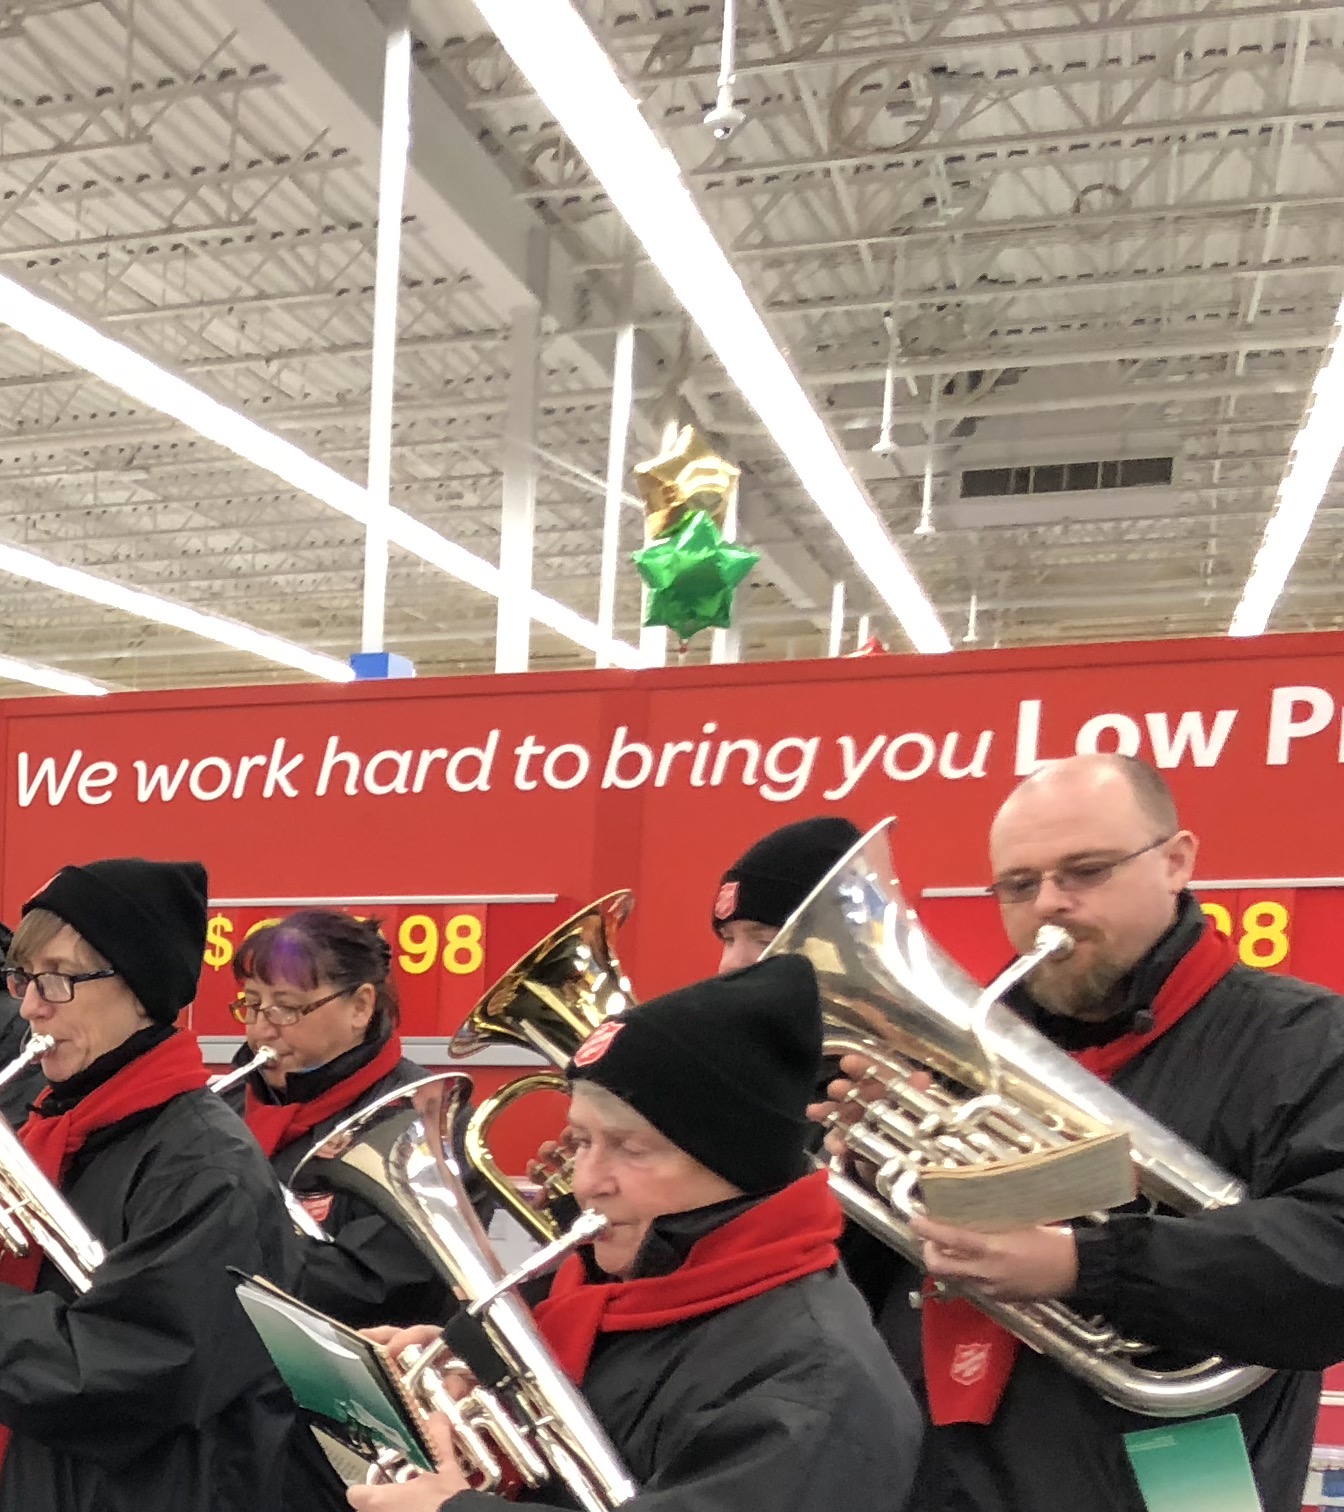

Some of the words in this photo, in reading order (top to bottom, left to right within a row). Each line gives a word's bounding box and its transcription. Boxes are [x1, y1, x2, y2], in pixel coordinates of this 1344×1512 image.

[16, 749, 118, 807] We
[133, 737, 305, 803] work
[314, 729, 502, 797] hard
[513, 733, 591, 792] to
[600, 722, 819, 803] bring
[821, 728, 994, 802] you
[1013, 698, 1239, 777] Low
[398, 914, 484, 976] 98
